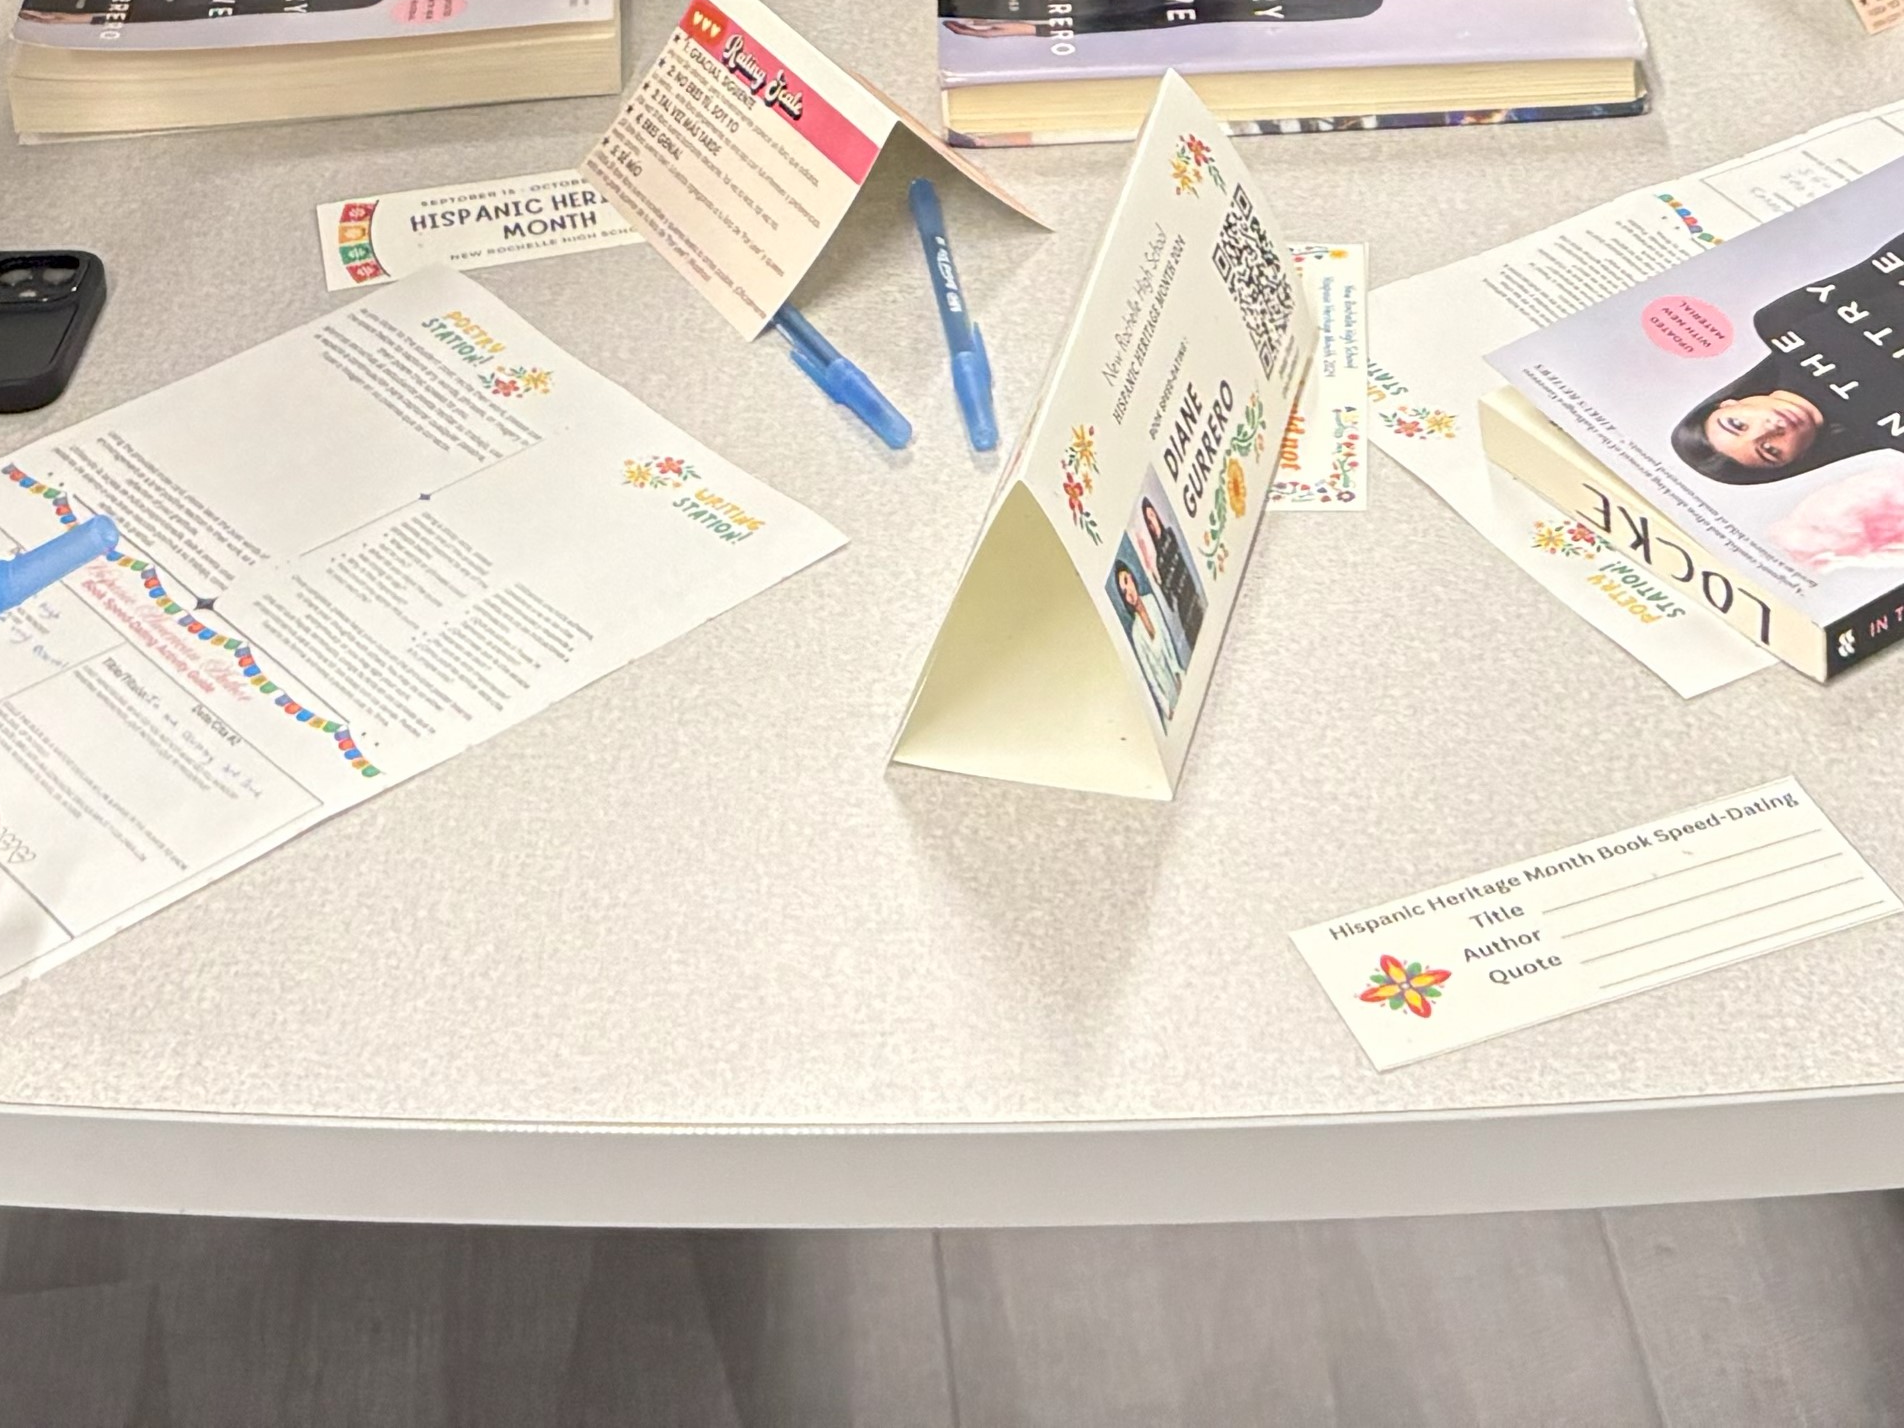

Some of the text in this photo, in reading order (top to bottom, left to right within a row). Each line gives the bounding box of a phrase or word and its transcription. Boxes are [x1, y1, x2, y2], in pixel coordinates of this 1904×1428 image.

[720, 75, 756, 110] SIGUIENTE
[724, 33, 804, 120] Rating Scale
[657, 94, 671, 112] TAL
[669, 105, 686, 124] VEZ
[697, 130, 721, 156] TARDE
[674, 71, 688, 87] NO
[685, 81, 703, 101] ERES
[710, 104, 728, 123] SOY
[725, 117, 739, 133] YO
[641, 118, 681, 160] ERES GENIAL
[529, 177, 589, 191] OCTOBE
[410, 198, 542, 231] HISPANIC
[503, 210, 596, 239] MONTH
[1101, 221, 1167, 387] New Rochelle High School
[1661, 307, 1711, 348] WITH NEW
[1679, 301, 1725, 339] MATERIAL
[421, 317, 493, 366] STATION!
[438, 307, 512, 356] POETRY
[1112, 233, 1185, 425] HISPANIC HERITAGE MONTH 2024
[1649, 316, 1694, 352] UPDATED
[1322, 360, 1335, 377] 2024
[1344, 346, 1359, 369] School
[1533, 363, 1580, 400] REVIEWS
[1771, 331, 1858, 399] THE
[1163, 382, 1202, 480] DIANE
[1182, 380, 1233, 517] GURRERO
[1280, 436, 1301, 471] not
[672, 493, 753, 544] STATION!
[689, 483, 769, 535] WRITING
[1578, 484, 1770, 644] LOCKE
[1598, 560, 1685, 617] STATION!
[1581, 567, 1665, 629] POETRY
[80, 578, 215, 694] Book Speed-Dating Activity Guide
[1869, 615, 1888, 637] IN
[1328, 793, 1798, 940] Hispanic Heritage Month Book Speed-Dating
[1469, 905, 1524, 927] Title
[1463, 929, 1540, 962] Author
[1488, 955, 1561, 984] Quote
